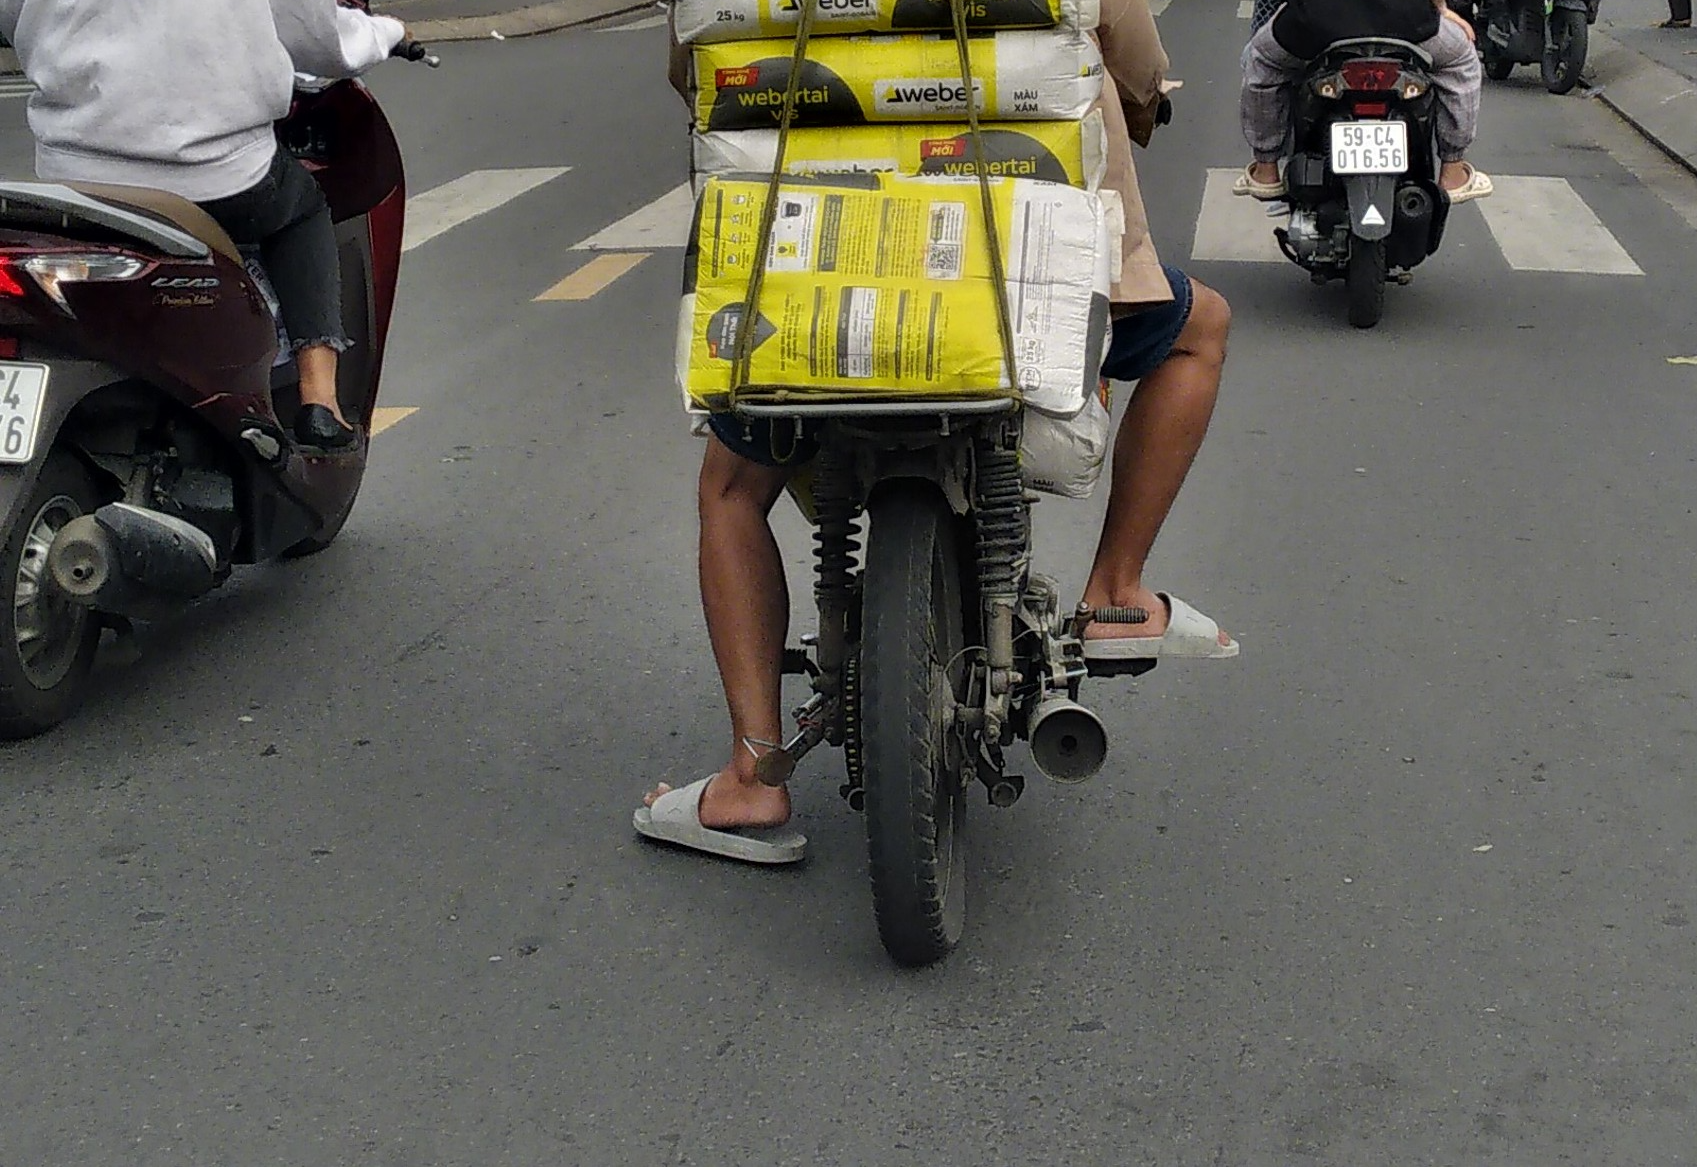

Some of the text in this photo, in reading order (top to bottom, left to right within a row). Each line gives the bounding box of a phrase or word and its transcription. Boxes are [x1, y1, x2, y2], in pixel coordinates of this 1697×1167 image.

[716, 10, 745, 22] 25 kg
[1013, 90, 1038, 101] MÀU
[1014, 103, 1039, 112] XÁM
[770, 109, 799, 121] vs
[1338, 148, 1402, 169] 016.56
